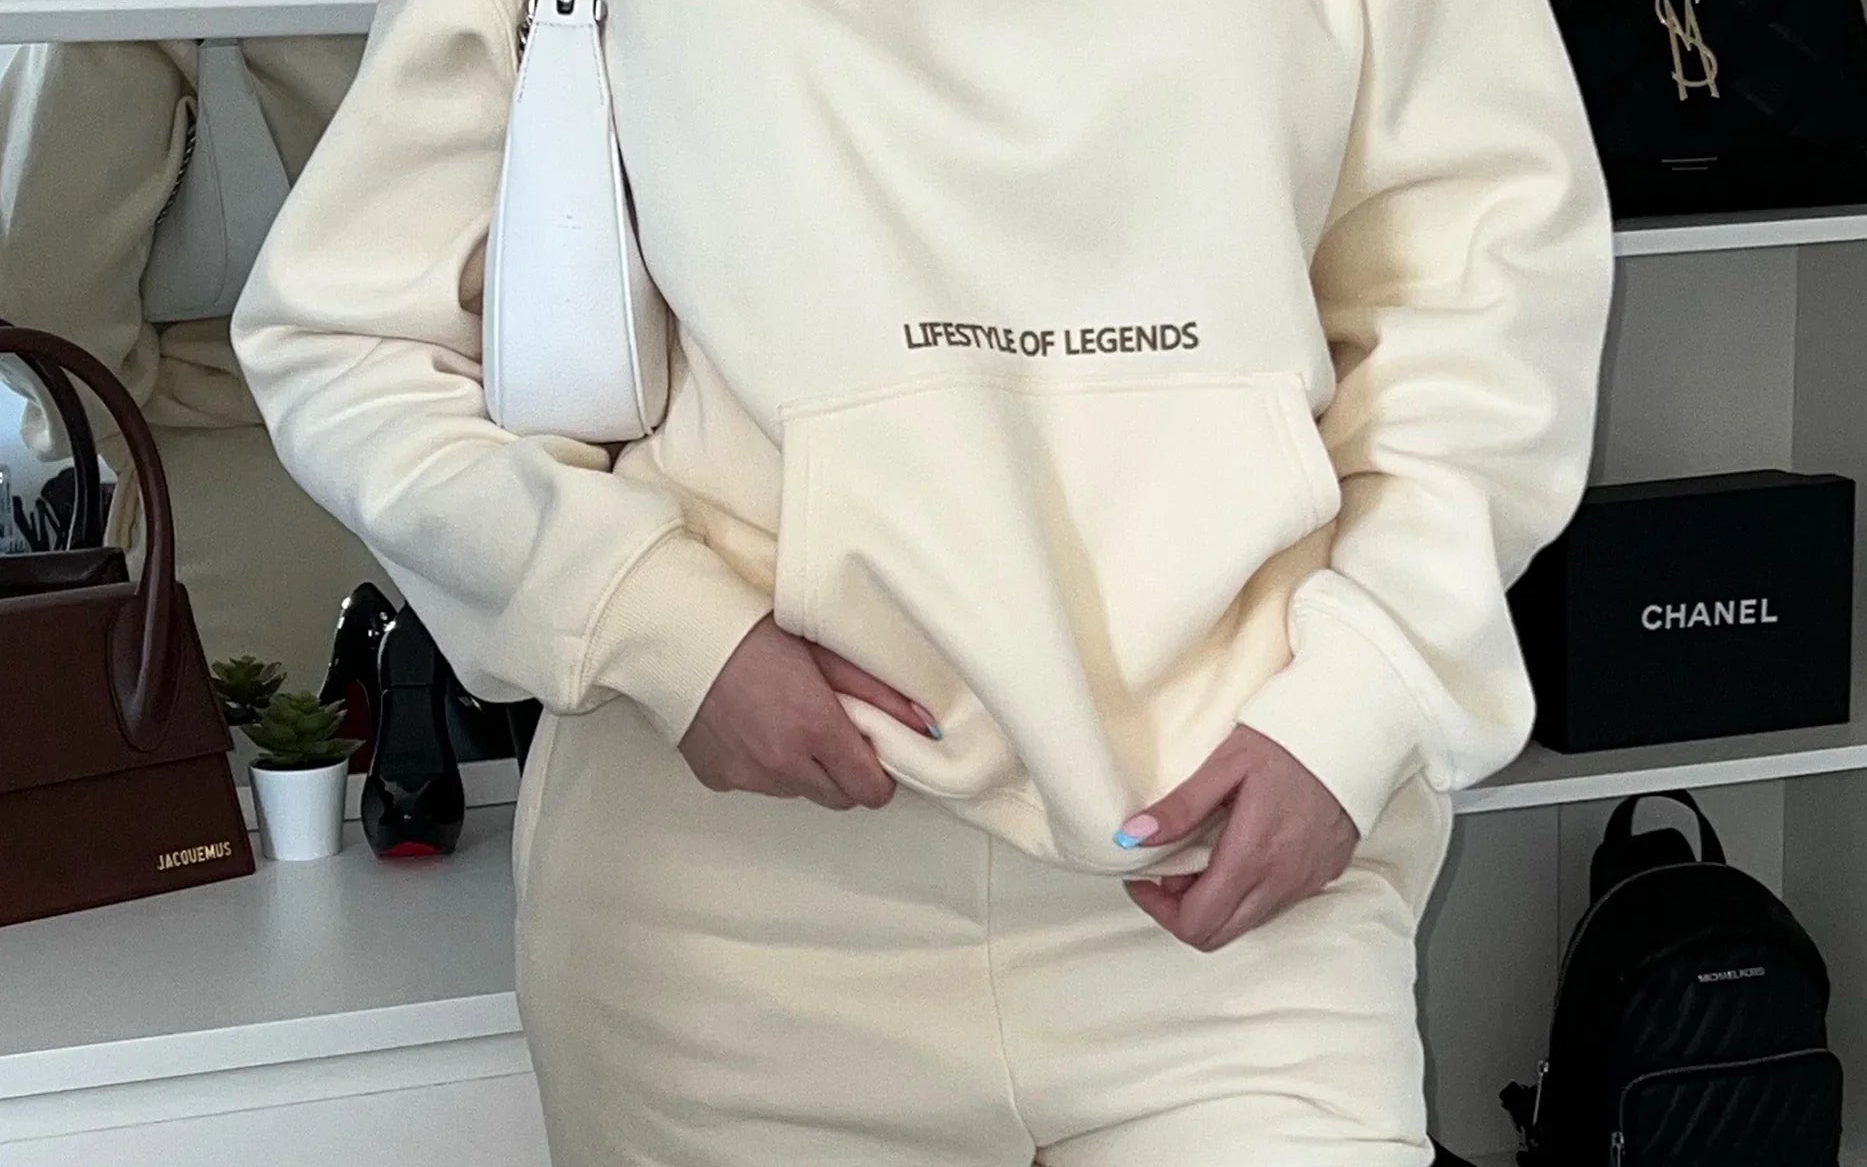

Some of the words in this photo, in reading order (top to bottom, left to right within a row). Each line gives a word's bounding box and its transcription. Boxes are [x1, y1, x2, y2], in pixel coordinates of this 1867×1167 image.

[903, 322, 1017, 354] LIFESTYLE
[1019, 330, 1055, 357] OF
[1064, 322, 1199, 355] LEGENDS
[1641, 598, 1778, 630] CHANEL
[157, 841, 232, 871] JACQUEMUS
